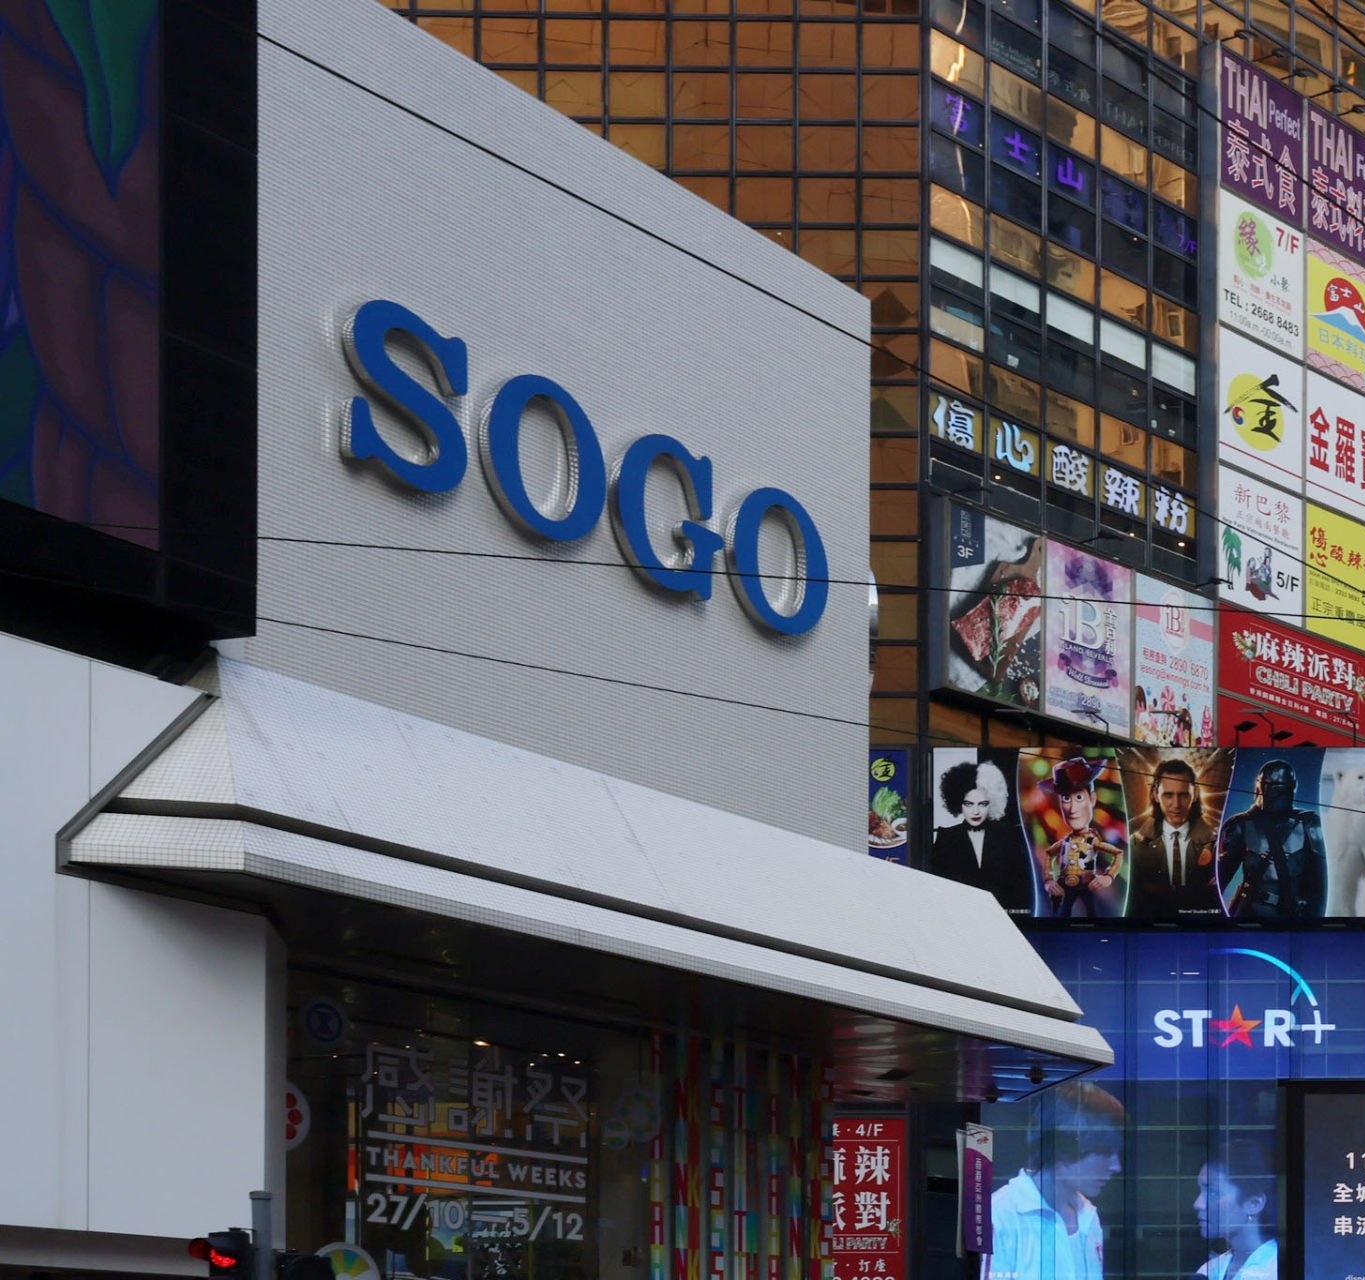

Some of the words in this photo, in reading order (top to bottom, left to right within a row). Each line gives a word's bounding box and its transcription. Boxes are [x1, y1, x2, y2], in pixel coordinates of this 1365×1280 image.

[1224, 56, 1268, 131] THAI
[1268, 98, 1301, 142] Perfect
[1226, 118, 1296, 216] 泰式食
[1310, 110, 1354, 182] THAI
[1275, 226, 1300, 255] 7/F
[1251, 302, 1274, 324] 2668
[1276, 317, 1300, 338] 8483
[344, 299, 830, 637] SOGO
[931, 394, 1189, 535] 傷心酸辣粉
[1233, 482, 1291, 525] 新巴黎
[1275, 571, 1300, 593] 5/F
[1253, 629, 1357, 691] 麻辣派對
[1255, 664, 1299, 696] CHILI
[1301, 679, 1354, 712] PARTY
[855, 1123, 884, 1137] 4/F
[365, 1145, 500, 1180] THANKFUL
[507, 1161, 588, 1190] WEEKS
[366, 1193, 466, 1231] 27/10
[512, 1204, 585, 1242] 5/12
[846, 1236, 889, 1251] PARTY
[858, 1259, 887, 1274] 訂座
